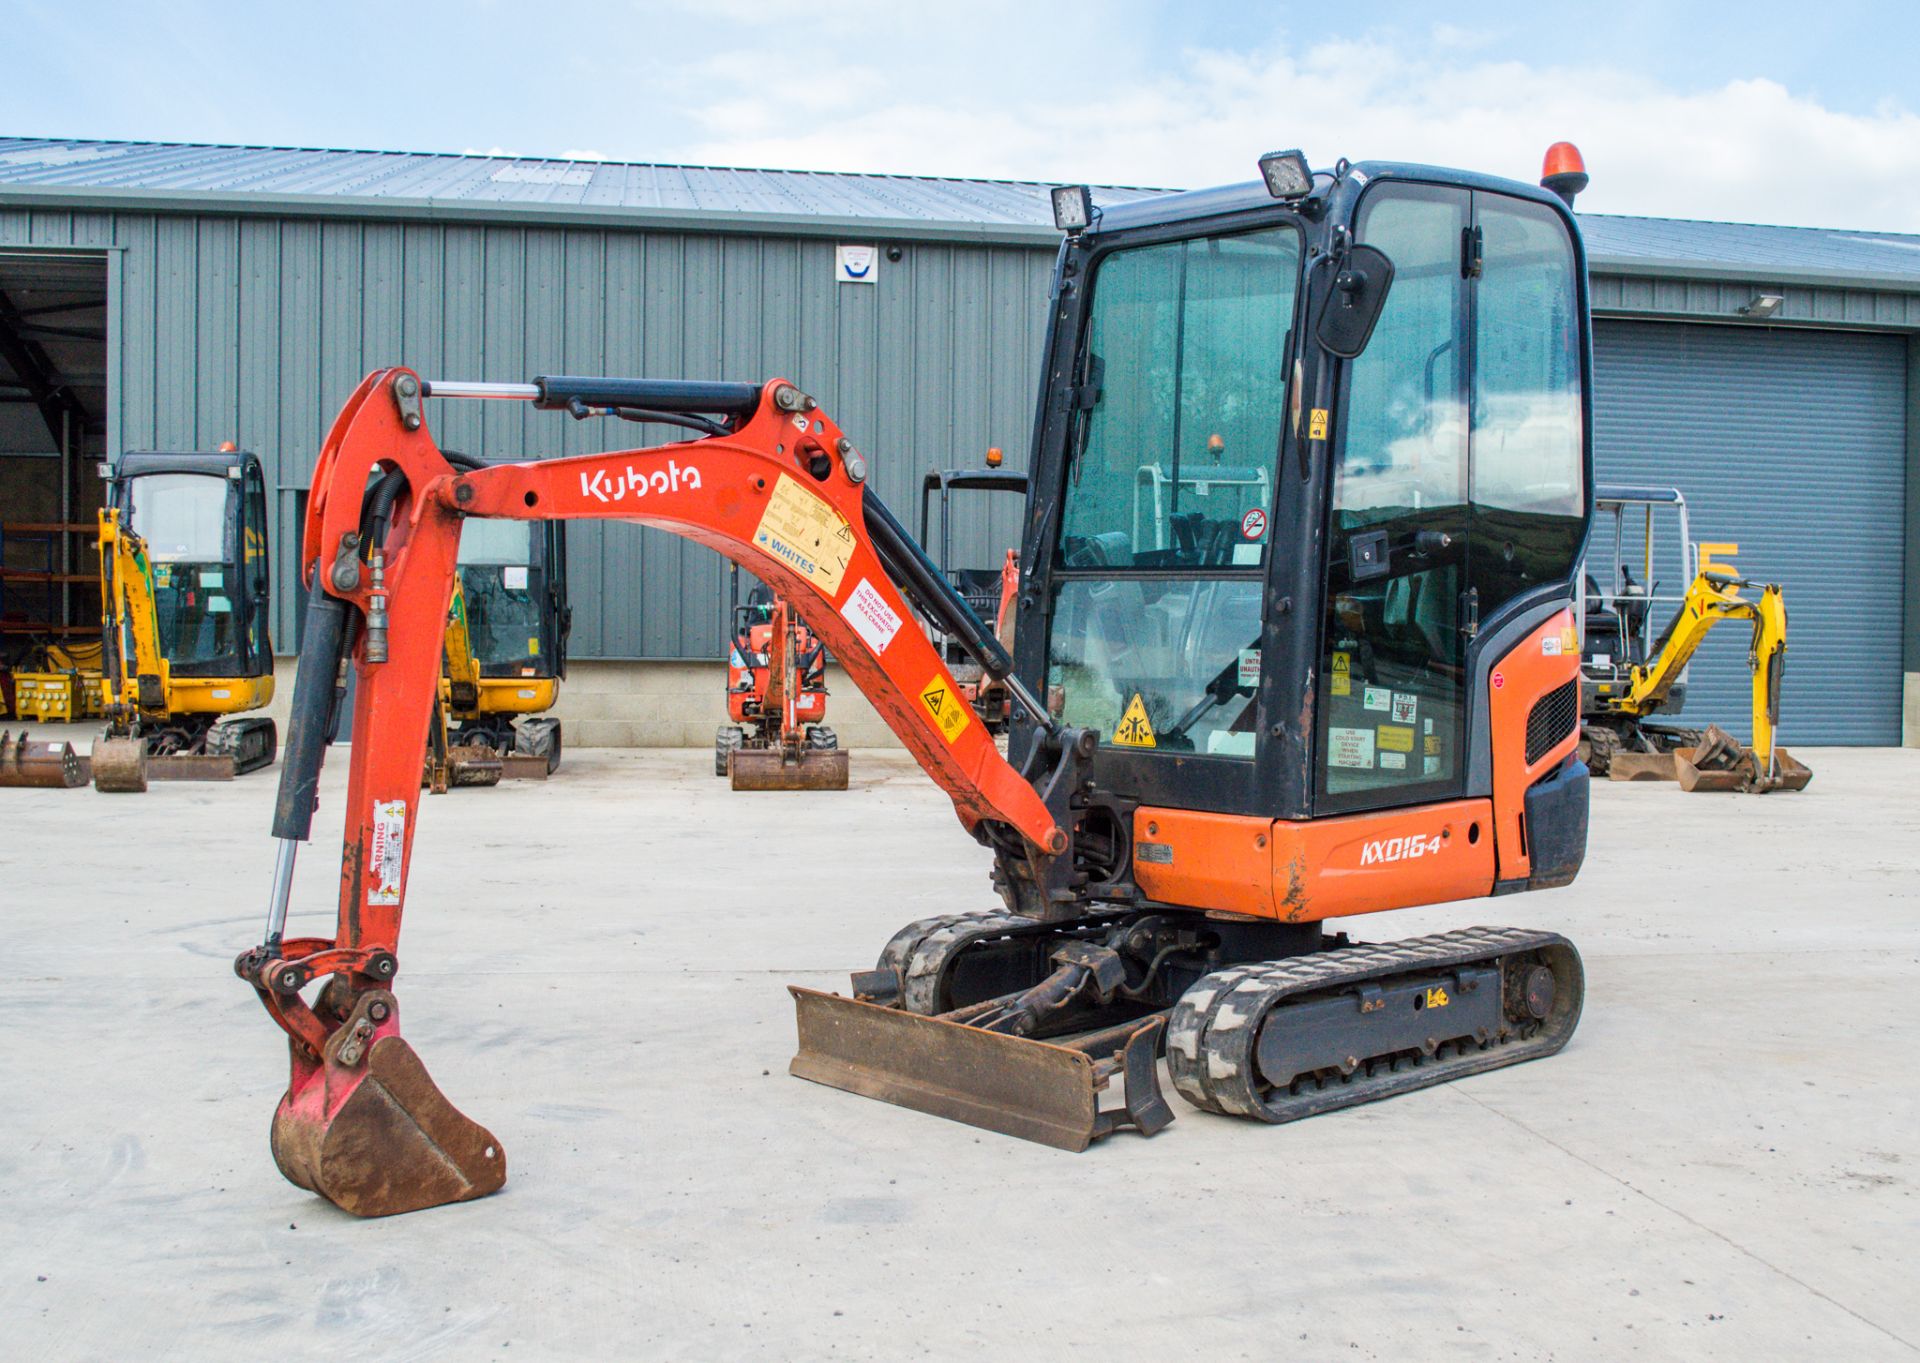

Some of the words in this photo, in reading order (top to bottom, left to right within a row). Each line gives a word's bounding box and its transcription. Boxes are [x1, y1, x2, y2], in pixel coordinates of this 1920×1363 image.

[580, 459, 702, 502] Kubota
[771, 539, 815, 575] WHITES
[856, 590, 868, 604] THIS
[867, 602, 895, 634] EXCAVATOR
[857, 603, 865, 611] AS
[868, 614, 886, 634] CRANE
[865, 588, 874, 599] DO
[873, 598, 885, 611] NOT
[883, 609, 894, 622] USE
[1360, 833, 1440, 866] KX016-4
